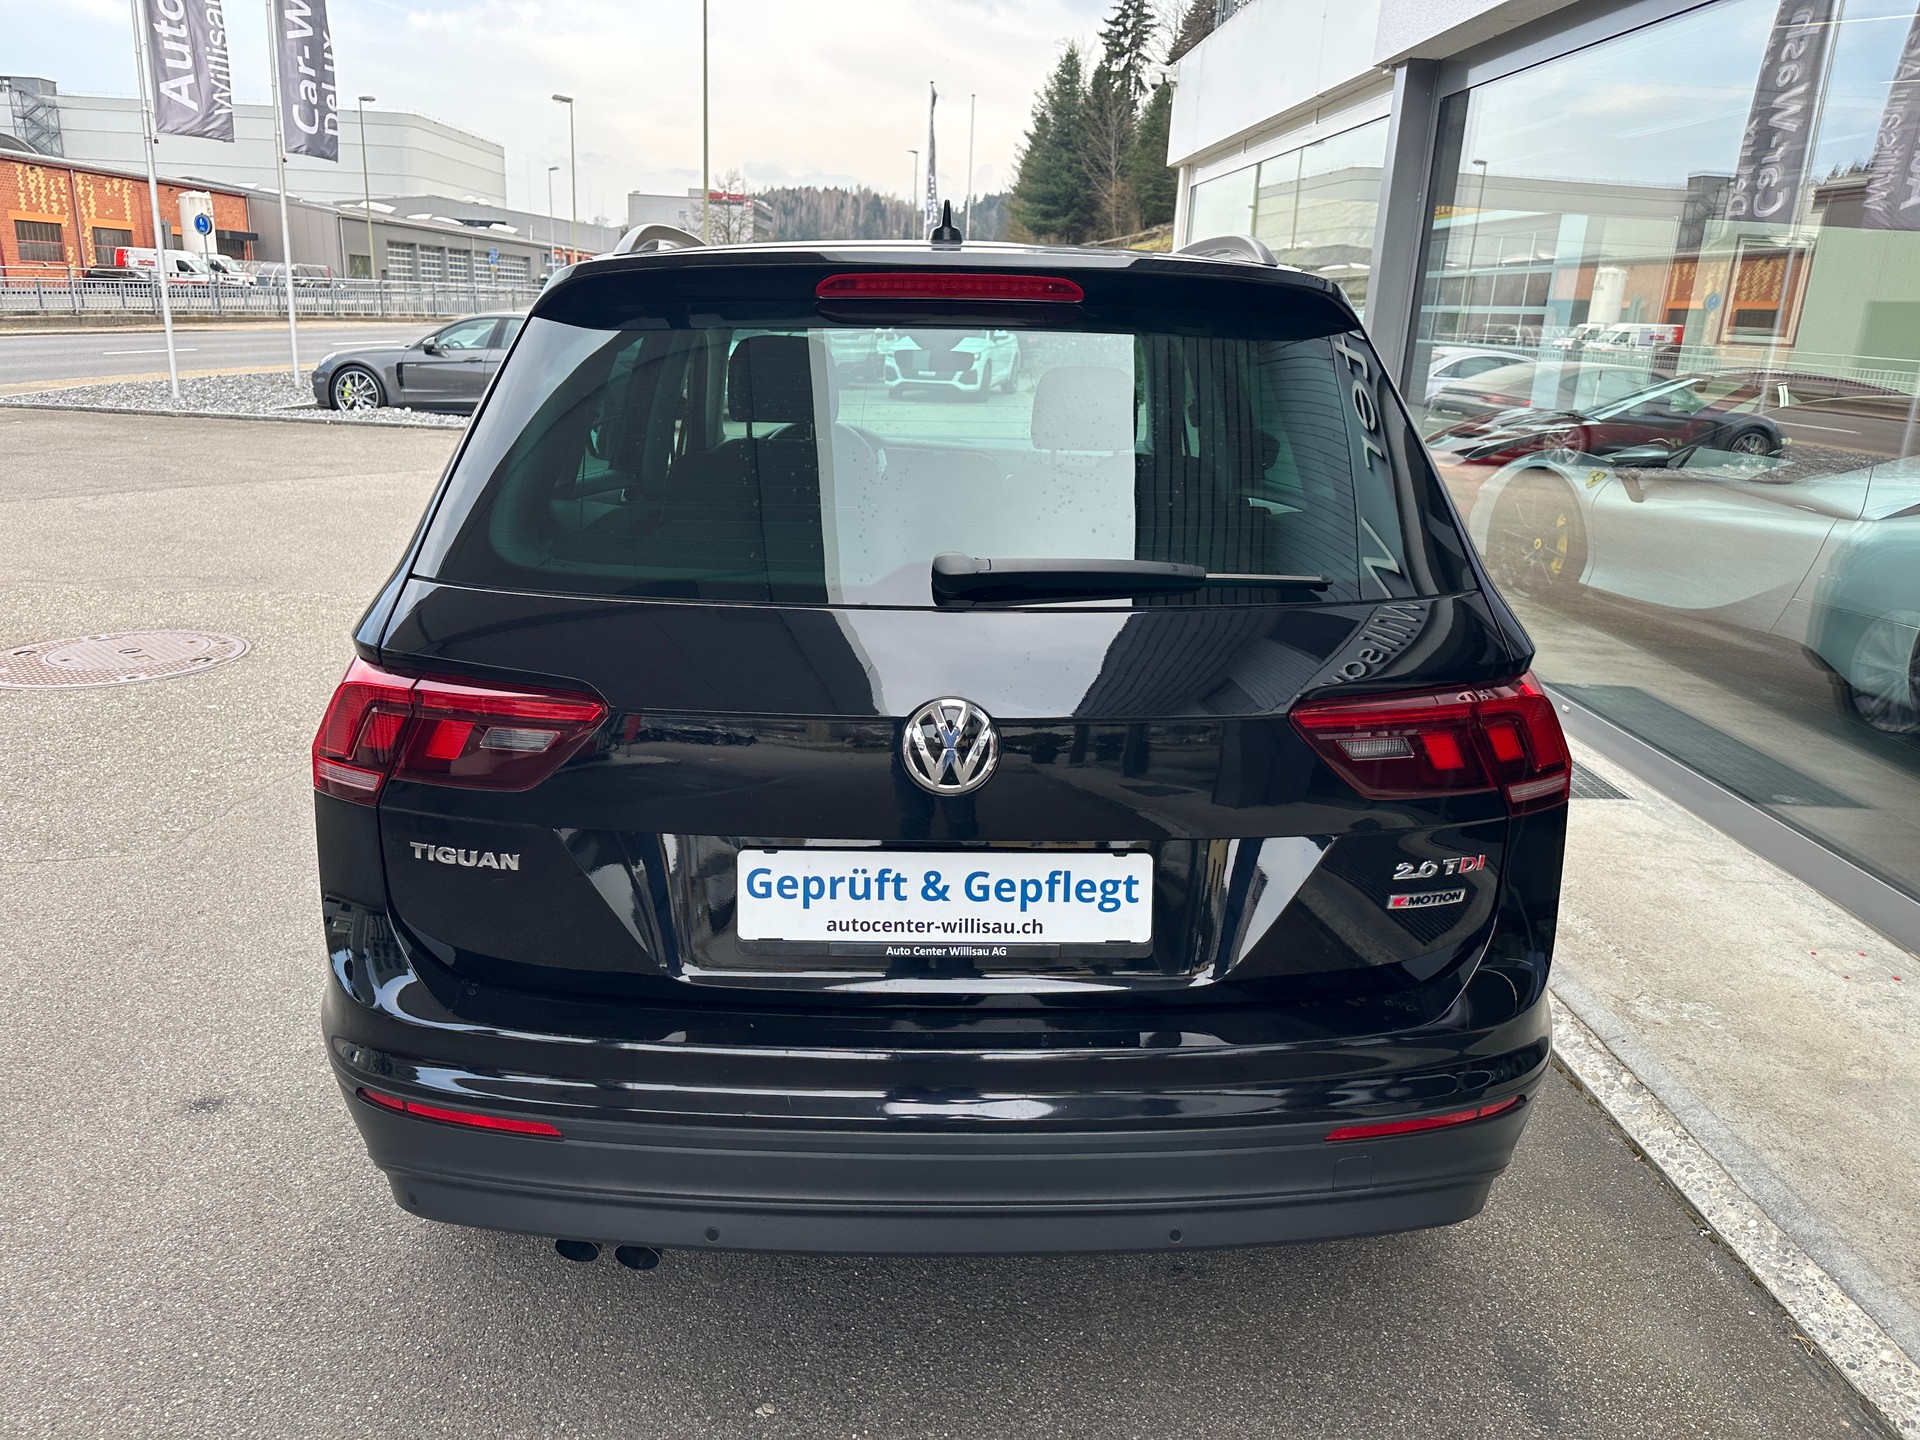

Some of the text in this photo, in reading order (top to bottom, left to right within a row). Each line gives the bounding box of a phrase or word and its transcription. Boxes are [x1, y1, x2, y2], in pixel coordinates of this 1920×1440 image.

[409, 841, 520, 871] TIGUAN
[1443, 854, 1486, 876] TDI
[746, 867, 1140, 912] Geprüft & Gepflegt
[826, 917, 1044, 935] autocenter-willisau.ch
[886, 946, 1007, 956] Auto Center Willisau AG
